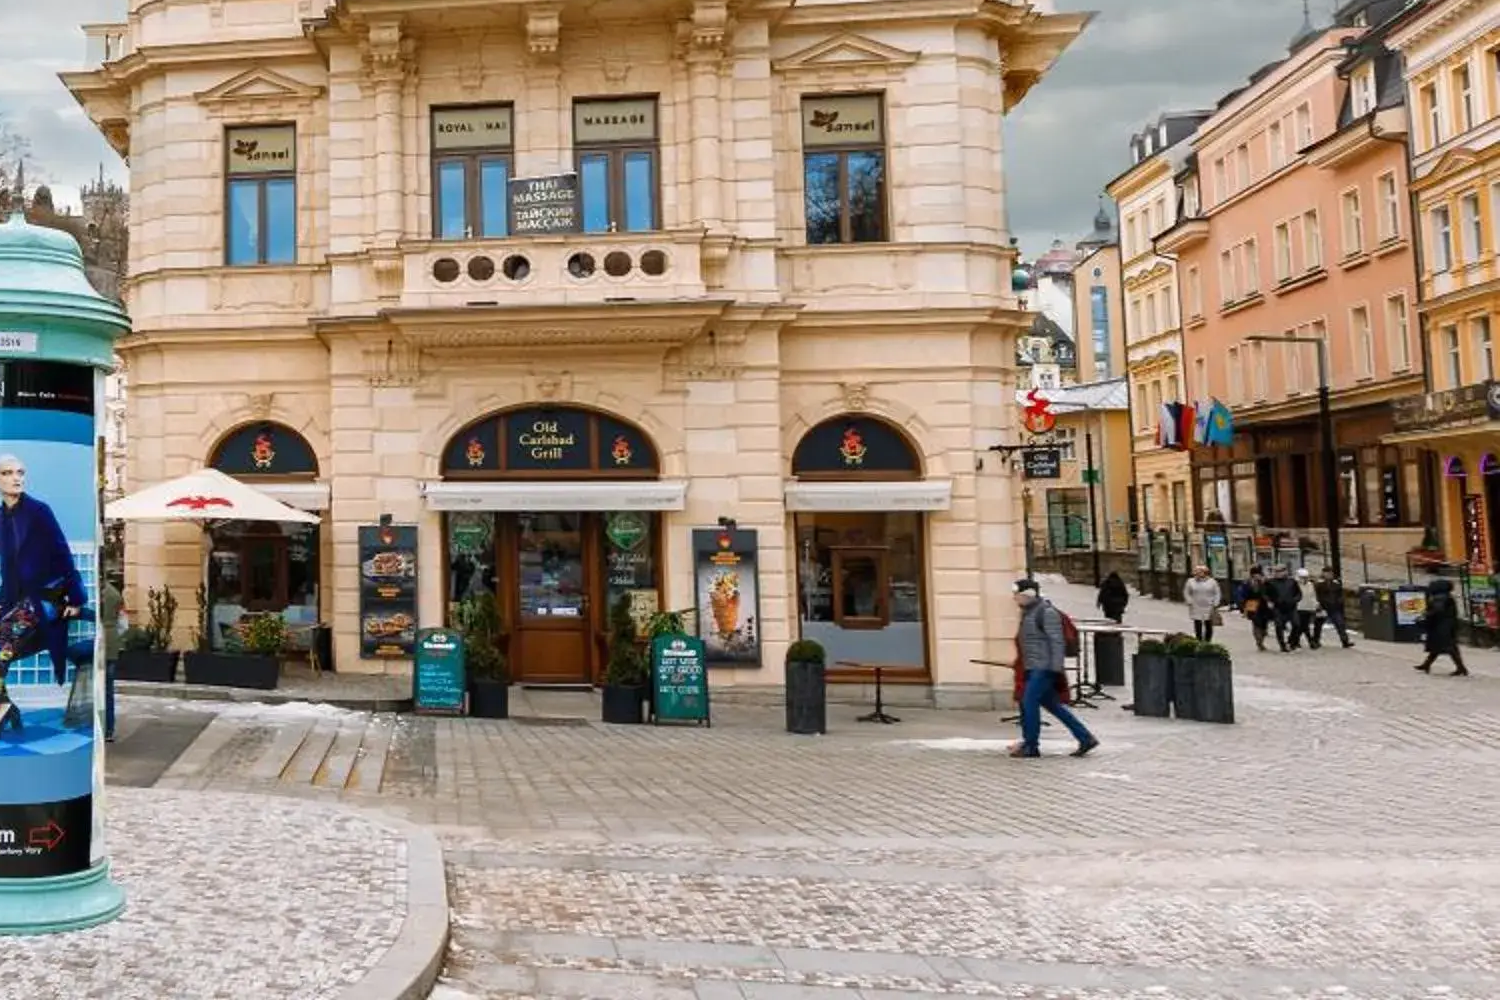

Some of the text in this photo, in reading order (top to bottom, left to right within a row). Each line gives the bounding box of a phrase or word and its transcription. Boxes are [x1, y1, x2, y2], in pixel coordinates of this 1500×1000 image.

[438, 123, 475, 133] ROYAL
[529, 180, 558, 191] THAI
[513, 190, 575, 203] MASSAGE
[533, 421, 558, 433] Old
[519, 433, 575, 446] Carlsbad
[531, 447, 563, 459] Grill
